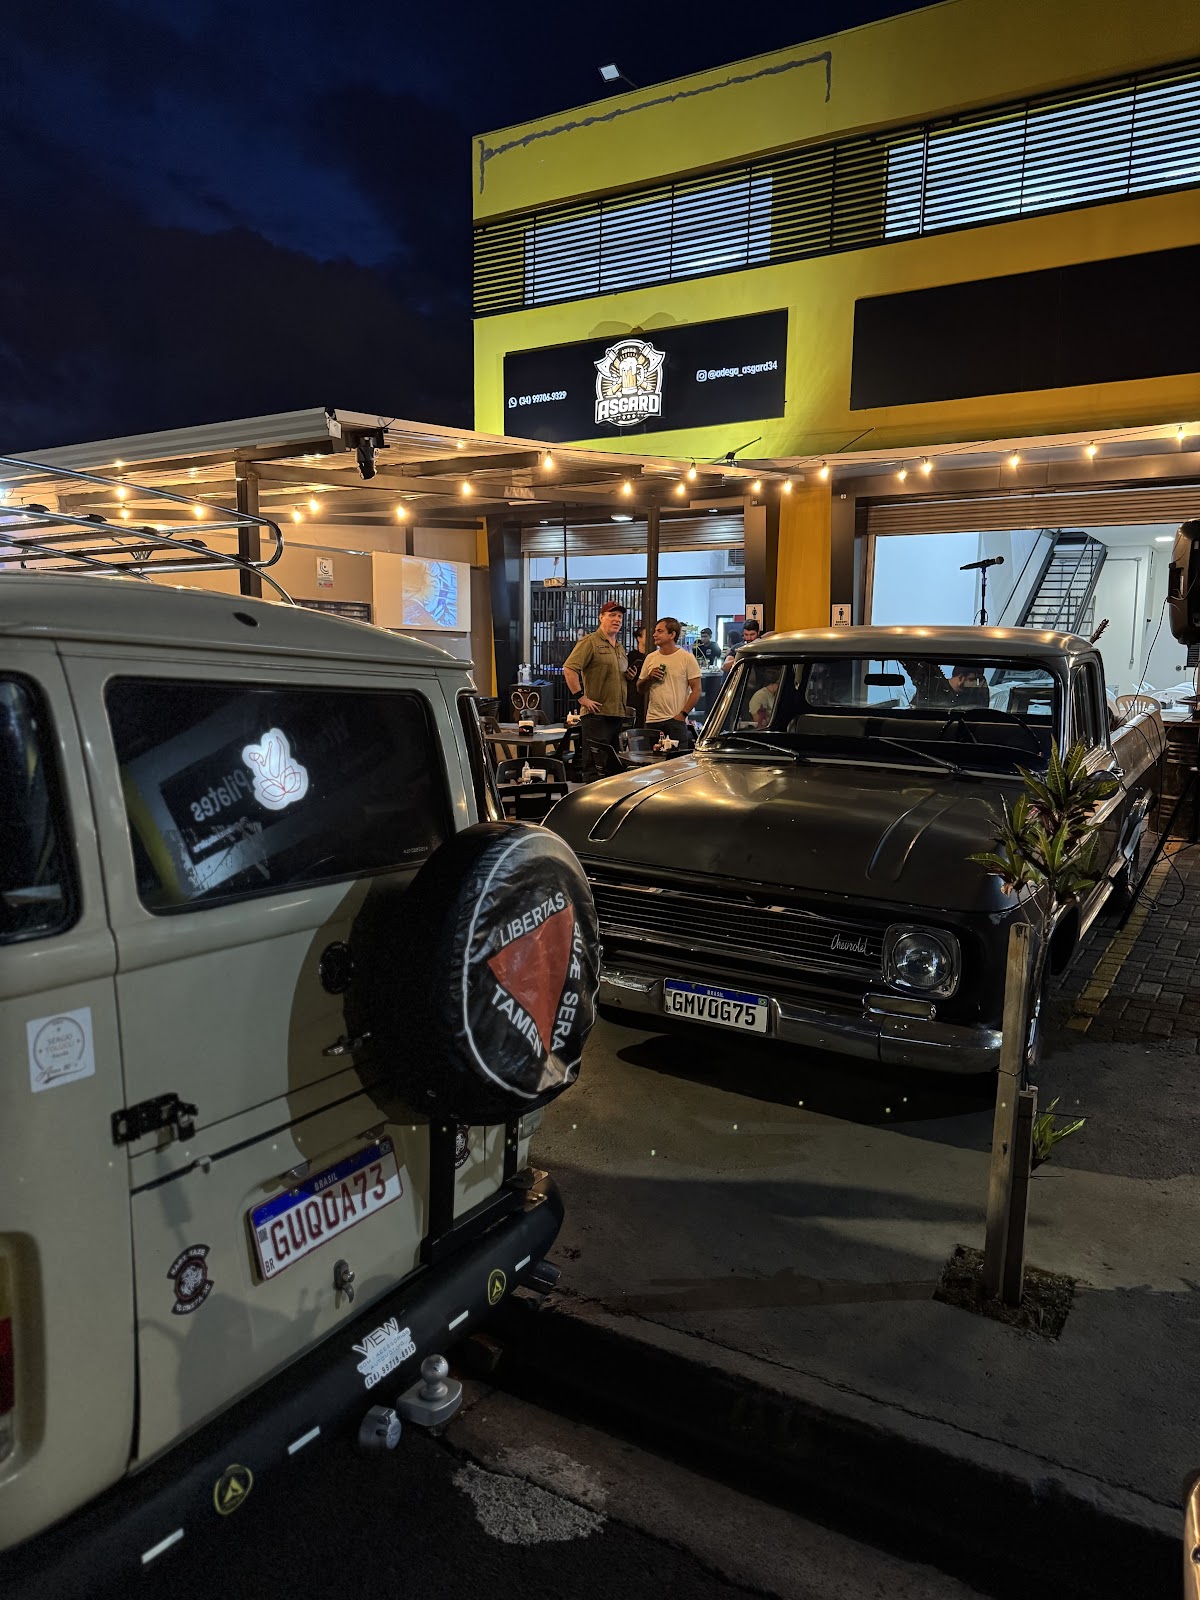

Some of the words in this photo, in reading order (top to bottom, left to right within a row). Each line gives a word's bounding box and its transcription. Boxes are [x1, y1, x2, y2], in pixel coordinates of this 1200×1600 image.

[708, 360, 778, 380] @adega_asgard34
[597, 394, 660, 421] ASGARD
[500, 892, 565, 947] LIBERTAS
[830, 933, 873, 956] Chevrolet
[490, 983, 543, 1058] TAMEN
[551, 990, 579, 1052] SERA
[314, 1172, 338, 1191] BRASIL
[264, 1258, 275, 1273] BR
[353, 1318, 398, 1354] VIEW
[366, 1371, 380, 1387] (34)
